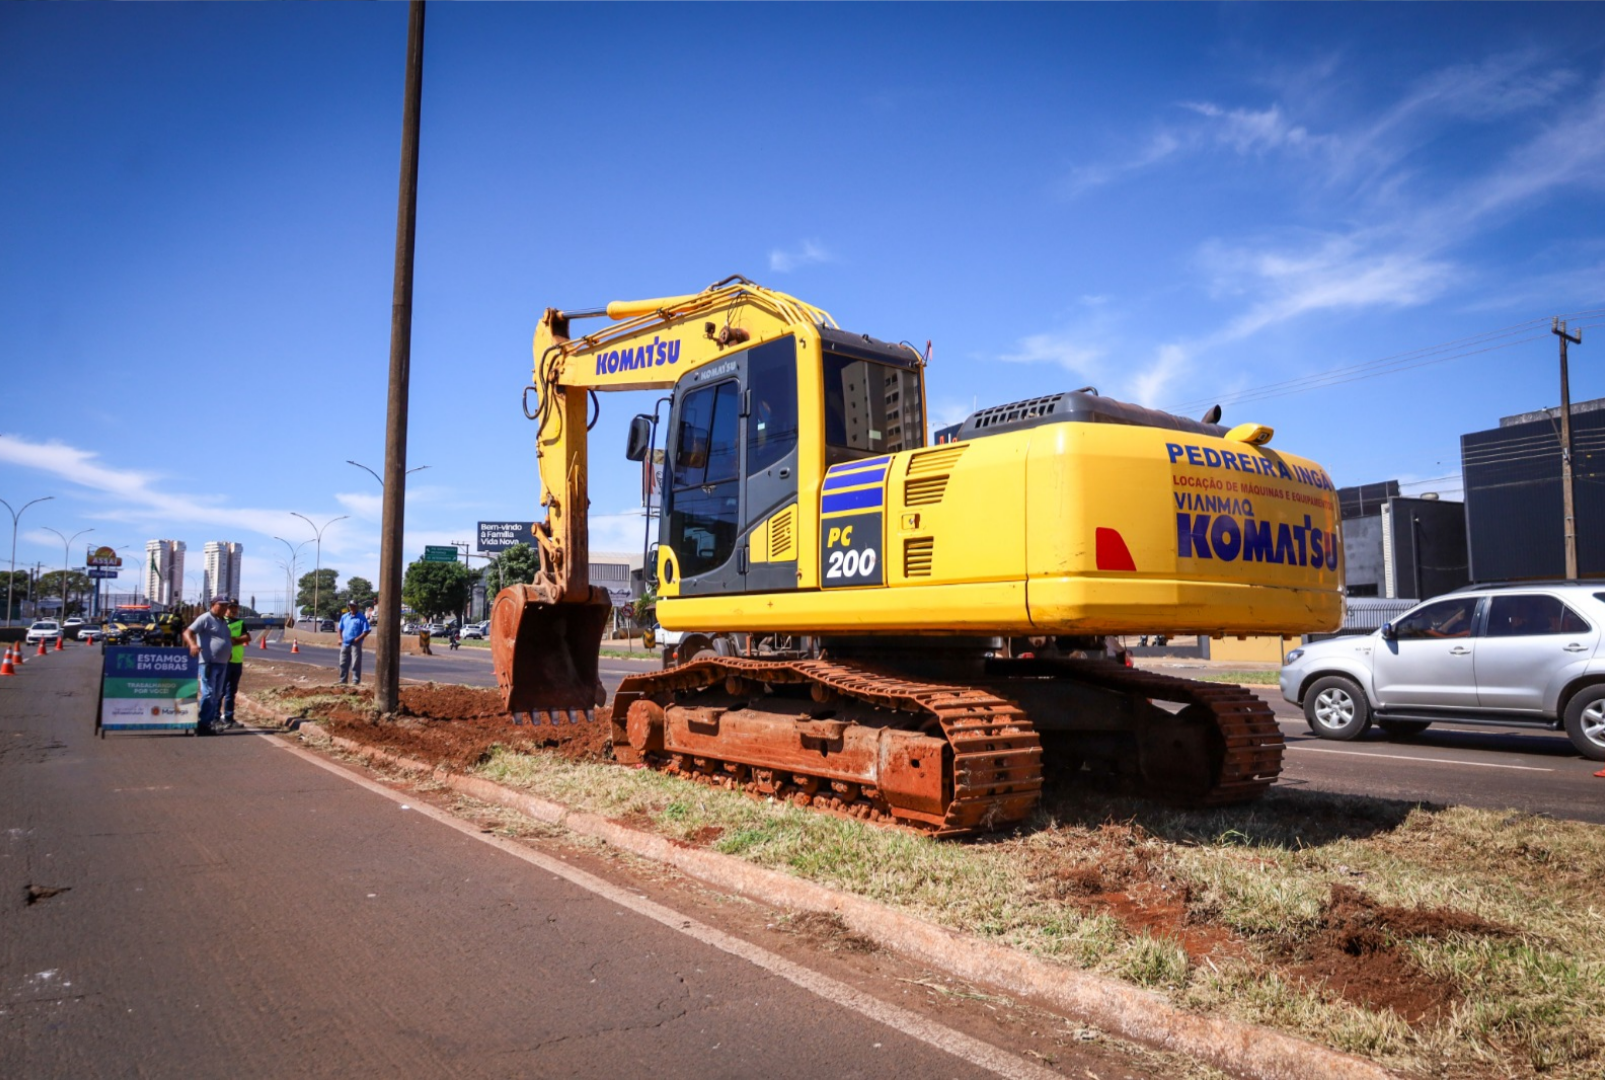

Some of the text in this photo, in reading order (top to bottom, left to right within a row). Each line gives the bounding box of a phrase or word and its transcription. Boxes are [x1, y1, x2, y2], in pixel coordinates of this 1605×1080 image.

[596, 336, 681, 375] KOMATSU
[700, 361, 737, 380] KOMATSU
[1166, 443, 1292, 480] PEDREIRA
[1173, 475, 1223, 491] LOCAÇÃO
[1226, 481, 1238, 492] DE
[1240, 483, 1284, 500] MÁQUINAS
[1285, 491, 1291, 501] E
[1174, 492, 1254, 517] VIANMAQ
[480, 523, 523, 531] Bem-vindo
[827, 525, 853, 548] PC
[1176, 512, 1338, 572] KOMATSU
[826, 547, 877, 579] 200
[137, 654, 188, 663] ESTAMOS
[137, 663, 188, 671] EM OBRAS
